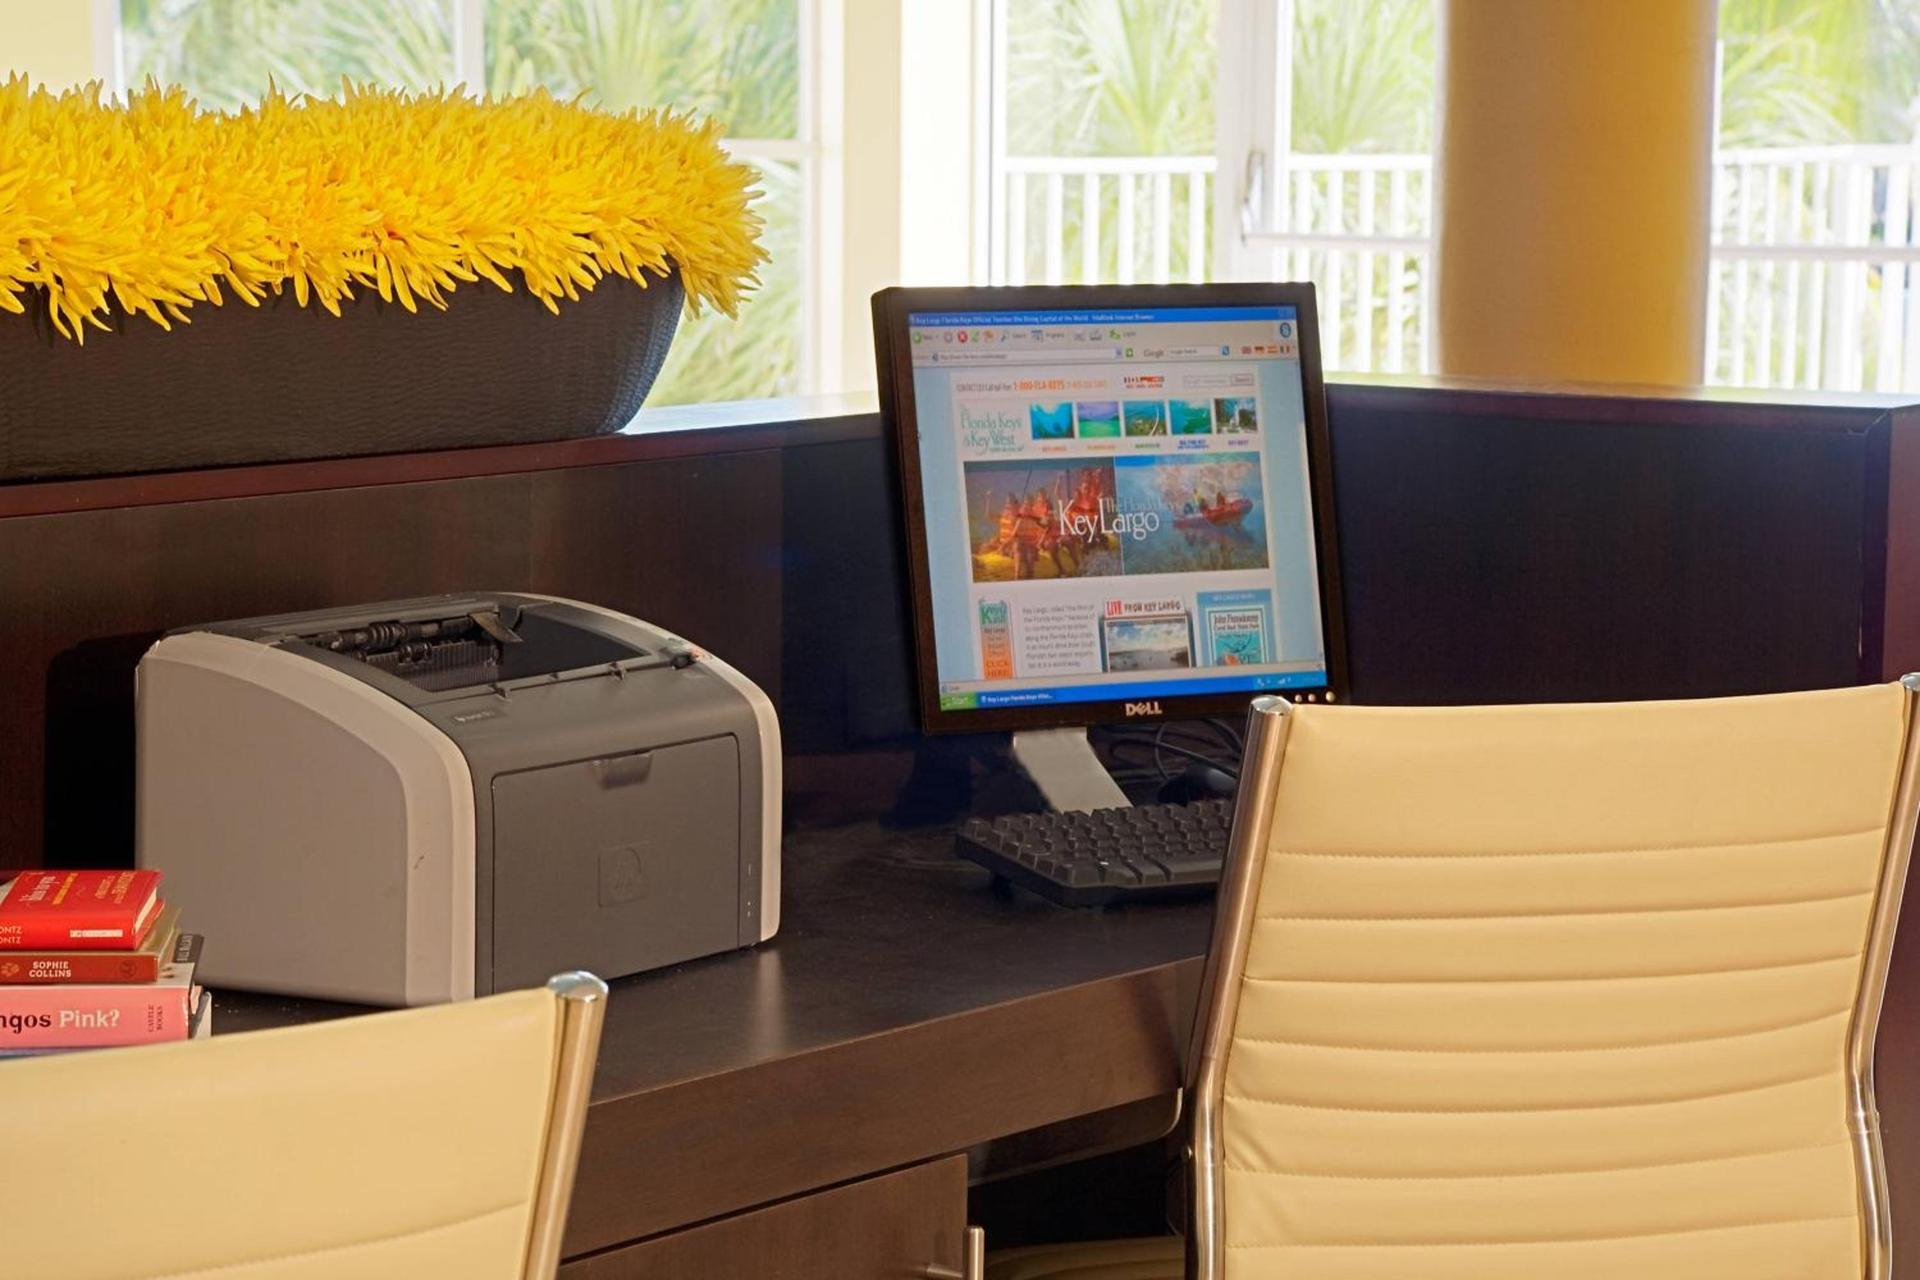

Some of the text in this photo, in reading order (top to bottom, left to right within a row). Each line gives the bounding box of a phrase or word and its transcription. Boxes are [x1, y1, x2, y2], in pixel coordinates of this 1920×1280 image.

[1058, 497, 1160, 543] Key Largo
[1106, 600, 1122, 616] LIVE
[1124, 601, 1142, 612] FROM
[1144, 601, 1157, 611] KEY
[1125, 701, 1163, 716] DELL
[32, 960, 69, 970] SOPHIE
[28, 969, 72, 978] COLLINS
[59, 1009, 120, 1028] Pink?
